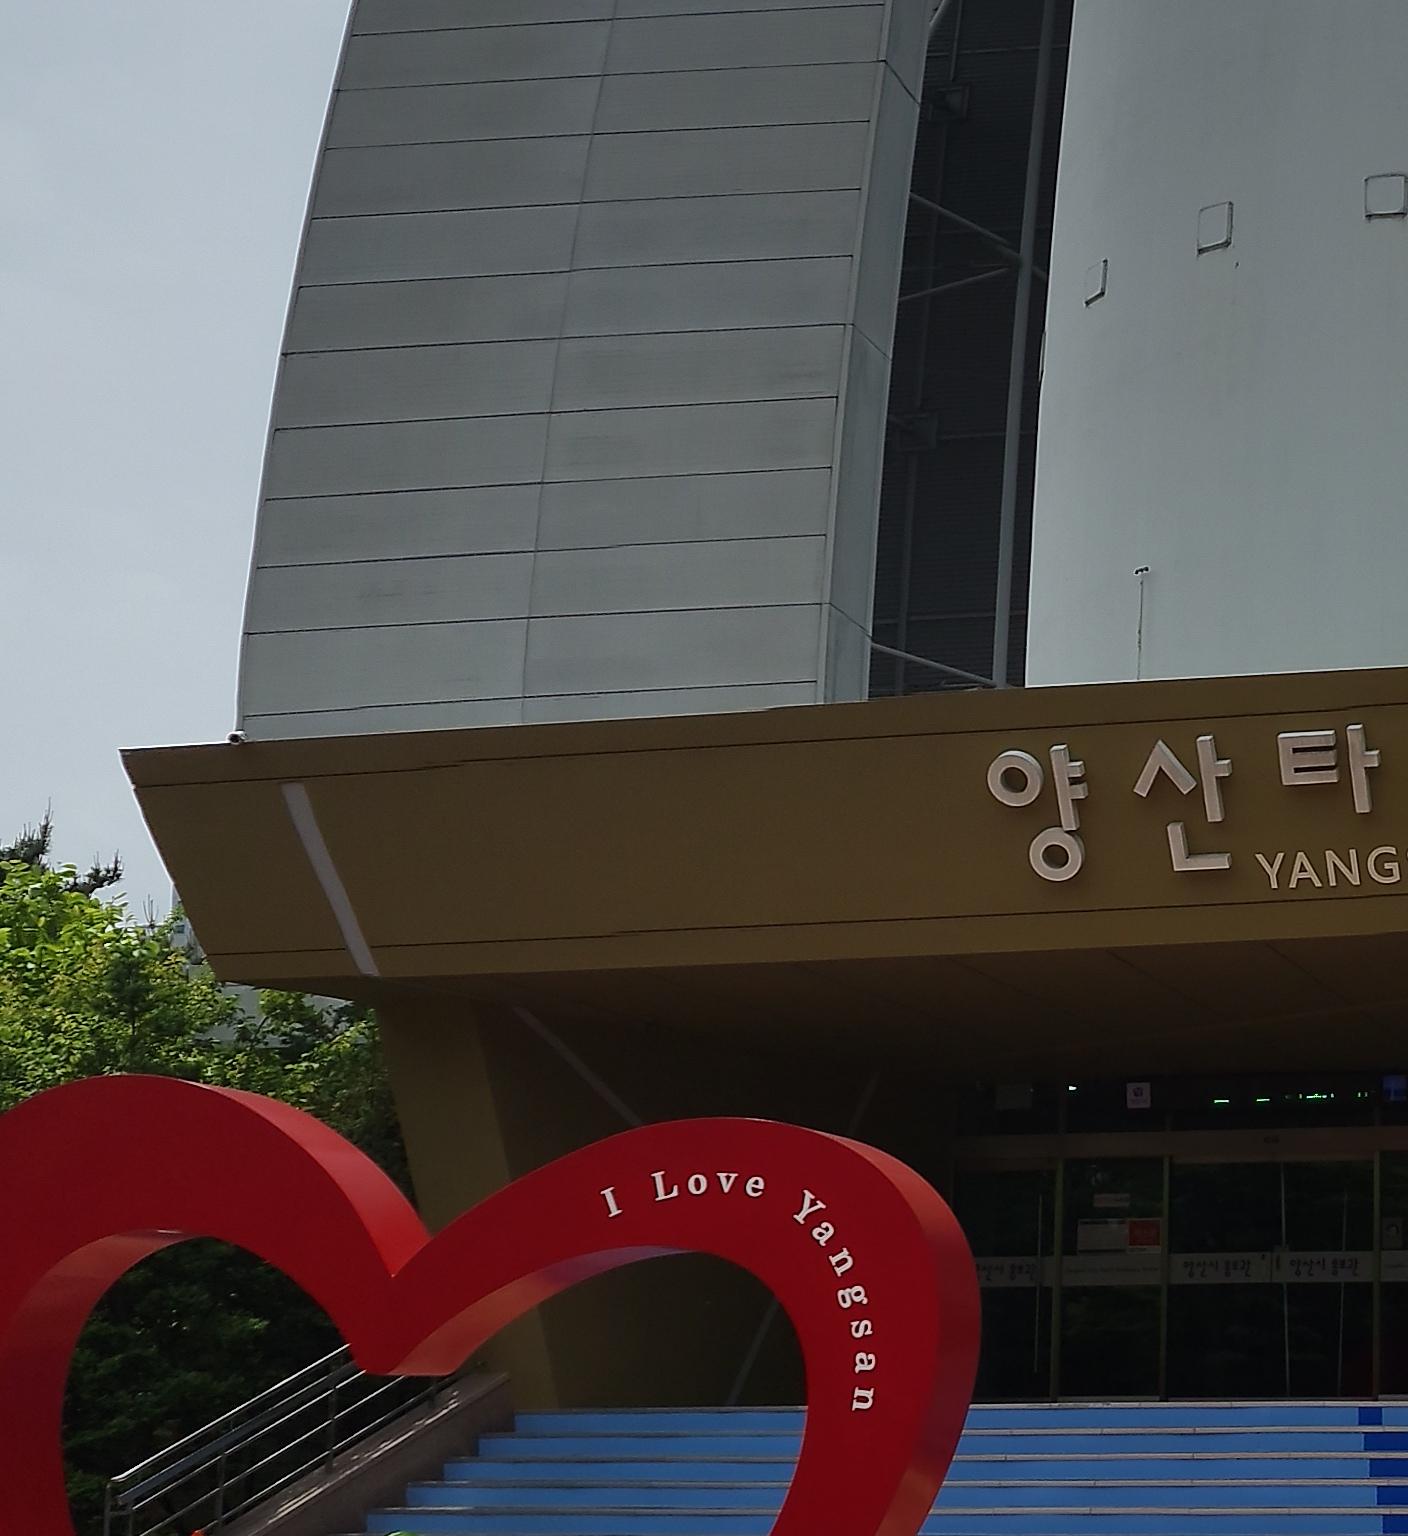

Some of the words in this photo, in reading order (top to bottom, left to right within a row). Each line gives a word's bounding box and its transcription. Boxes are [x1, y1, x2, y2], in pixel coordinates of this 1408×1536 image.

[600, 1186, 623, 1218] I
[651, 1170, 766, 1201] Love
[792, 1189, 876, 1412] Yangsan
